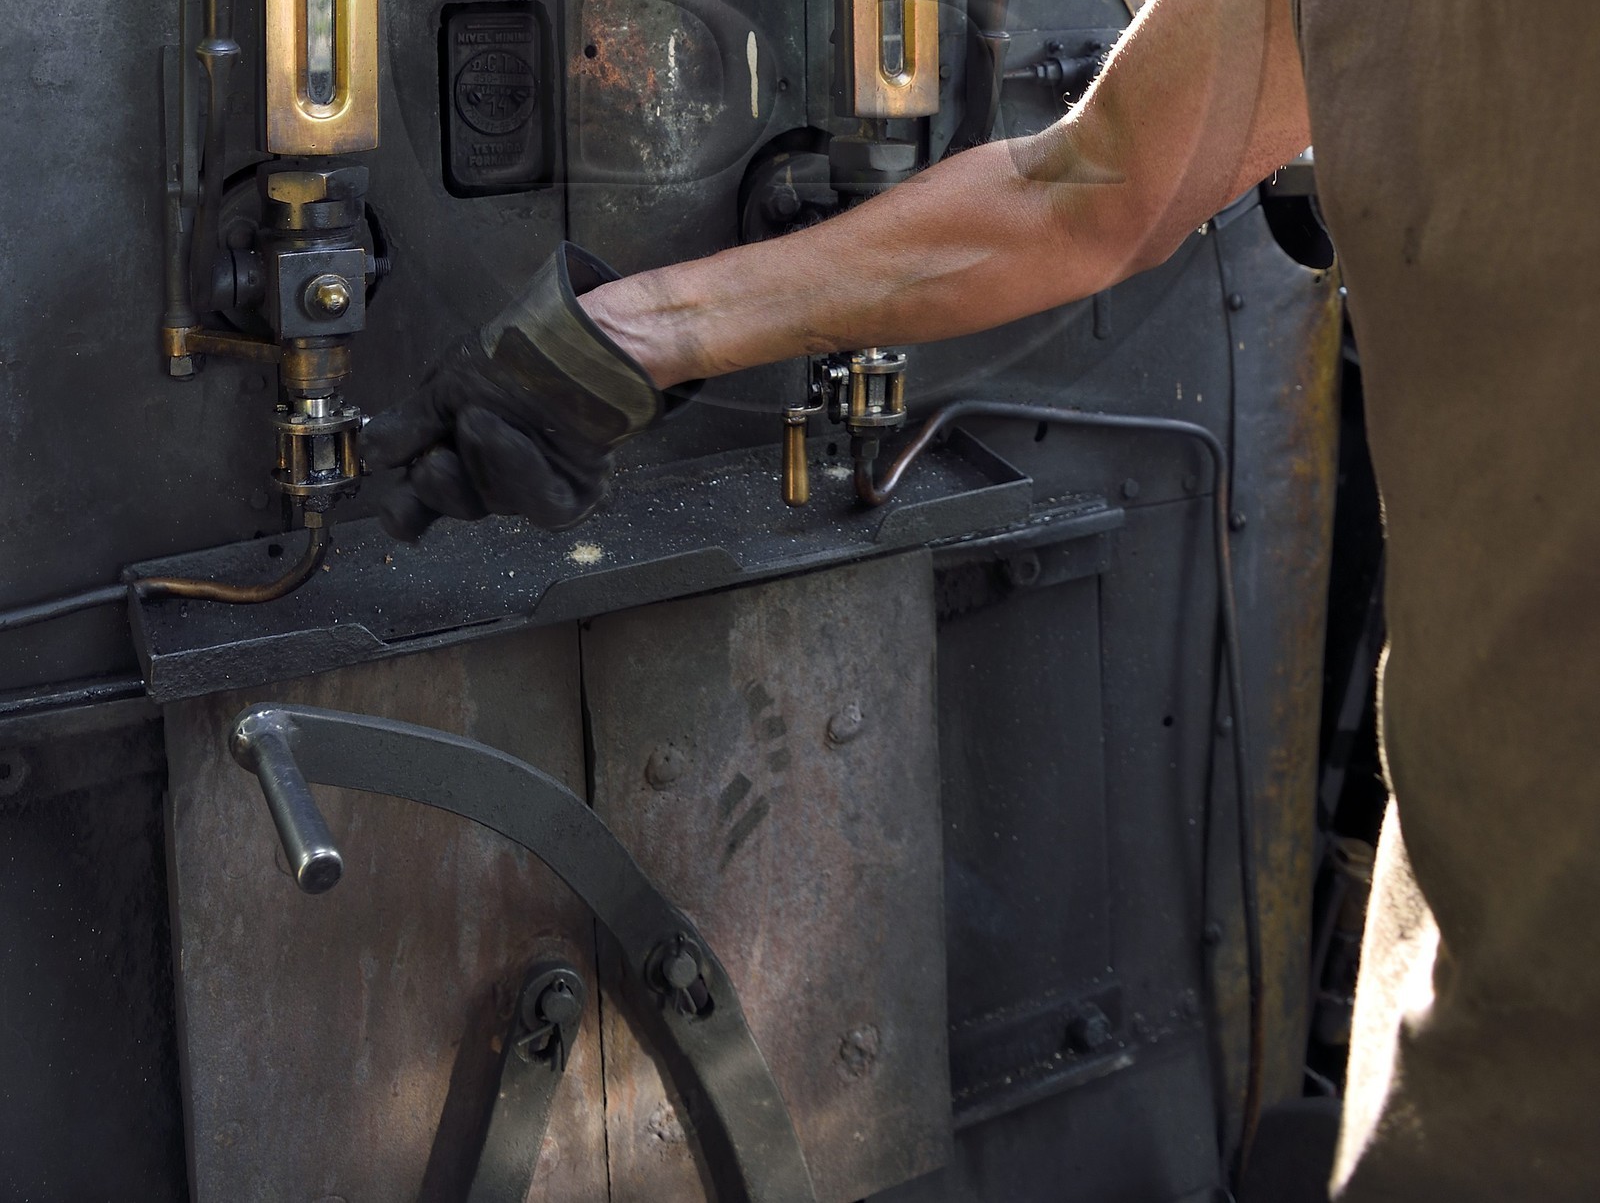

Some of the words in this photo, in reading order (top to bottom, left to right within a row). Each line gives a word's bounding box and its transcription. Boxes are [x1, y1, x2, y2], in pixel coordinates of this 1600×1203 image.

[457, 32, 491, 44] NIVEL
[487, 96, 506, 118] 14
[473, 143, 503, 155] TETO
